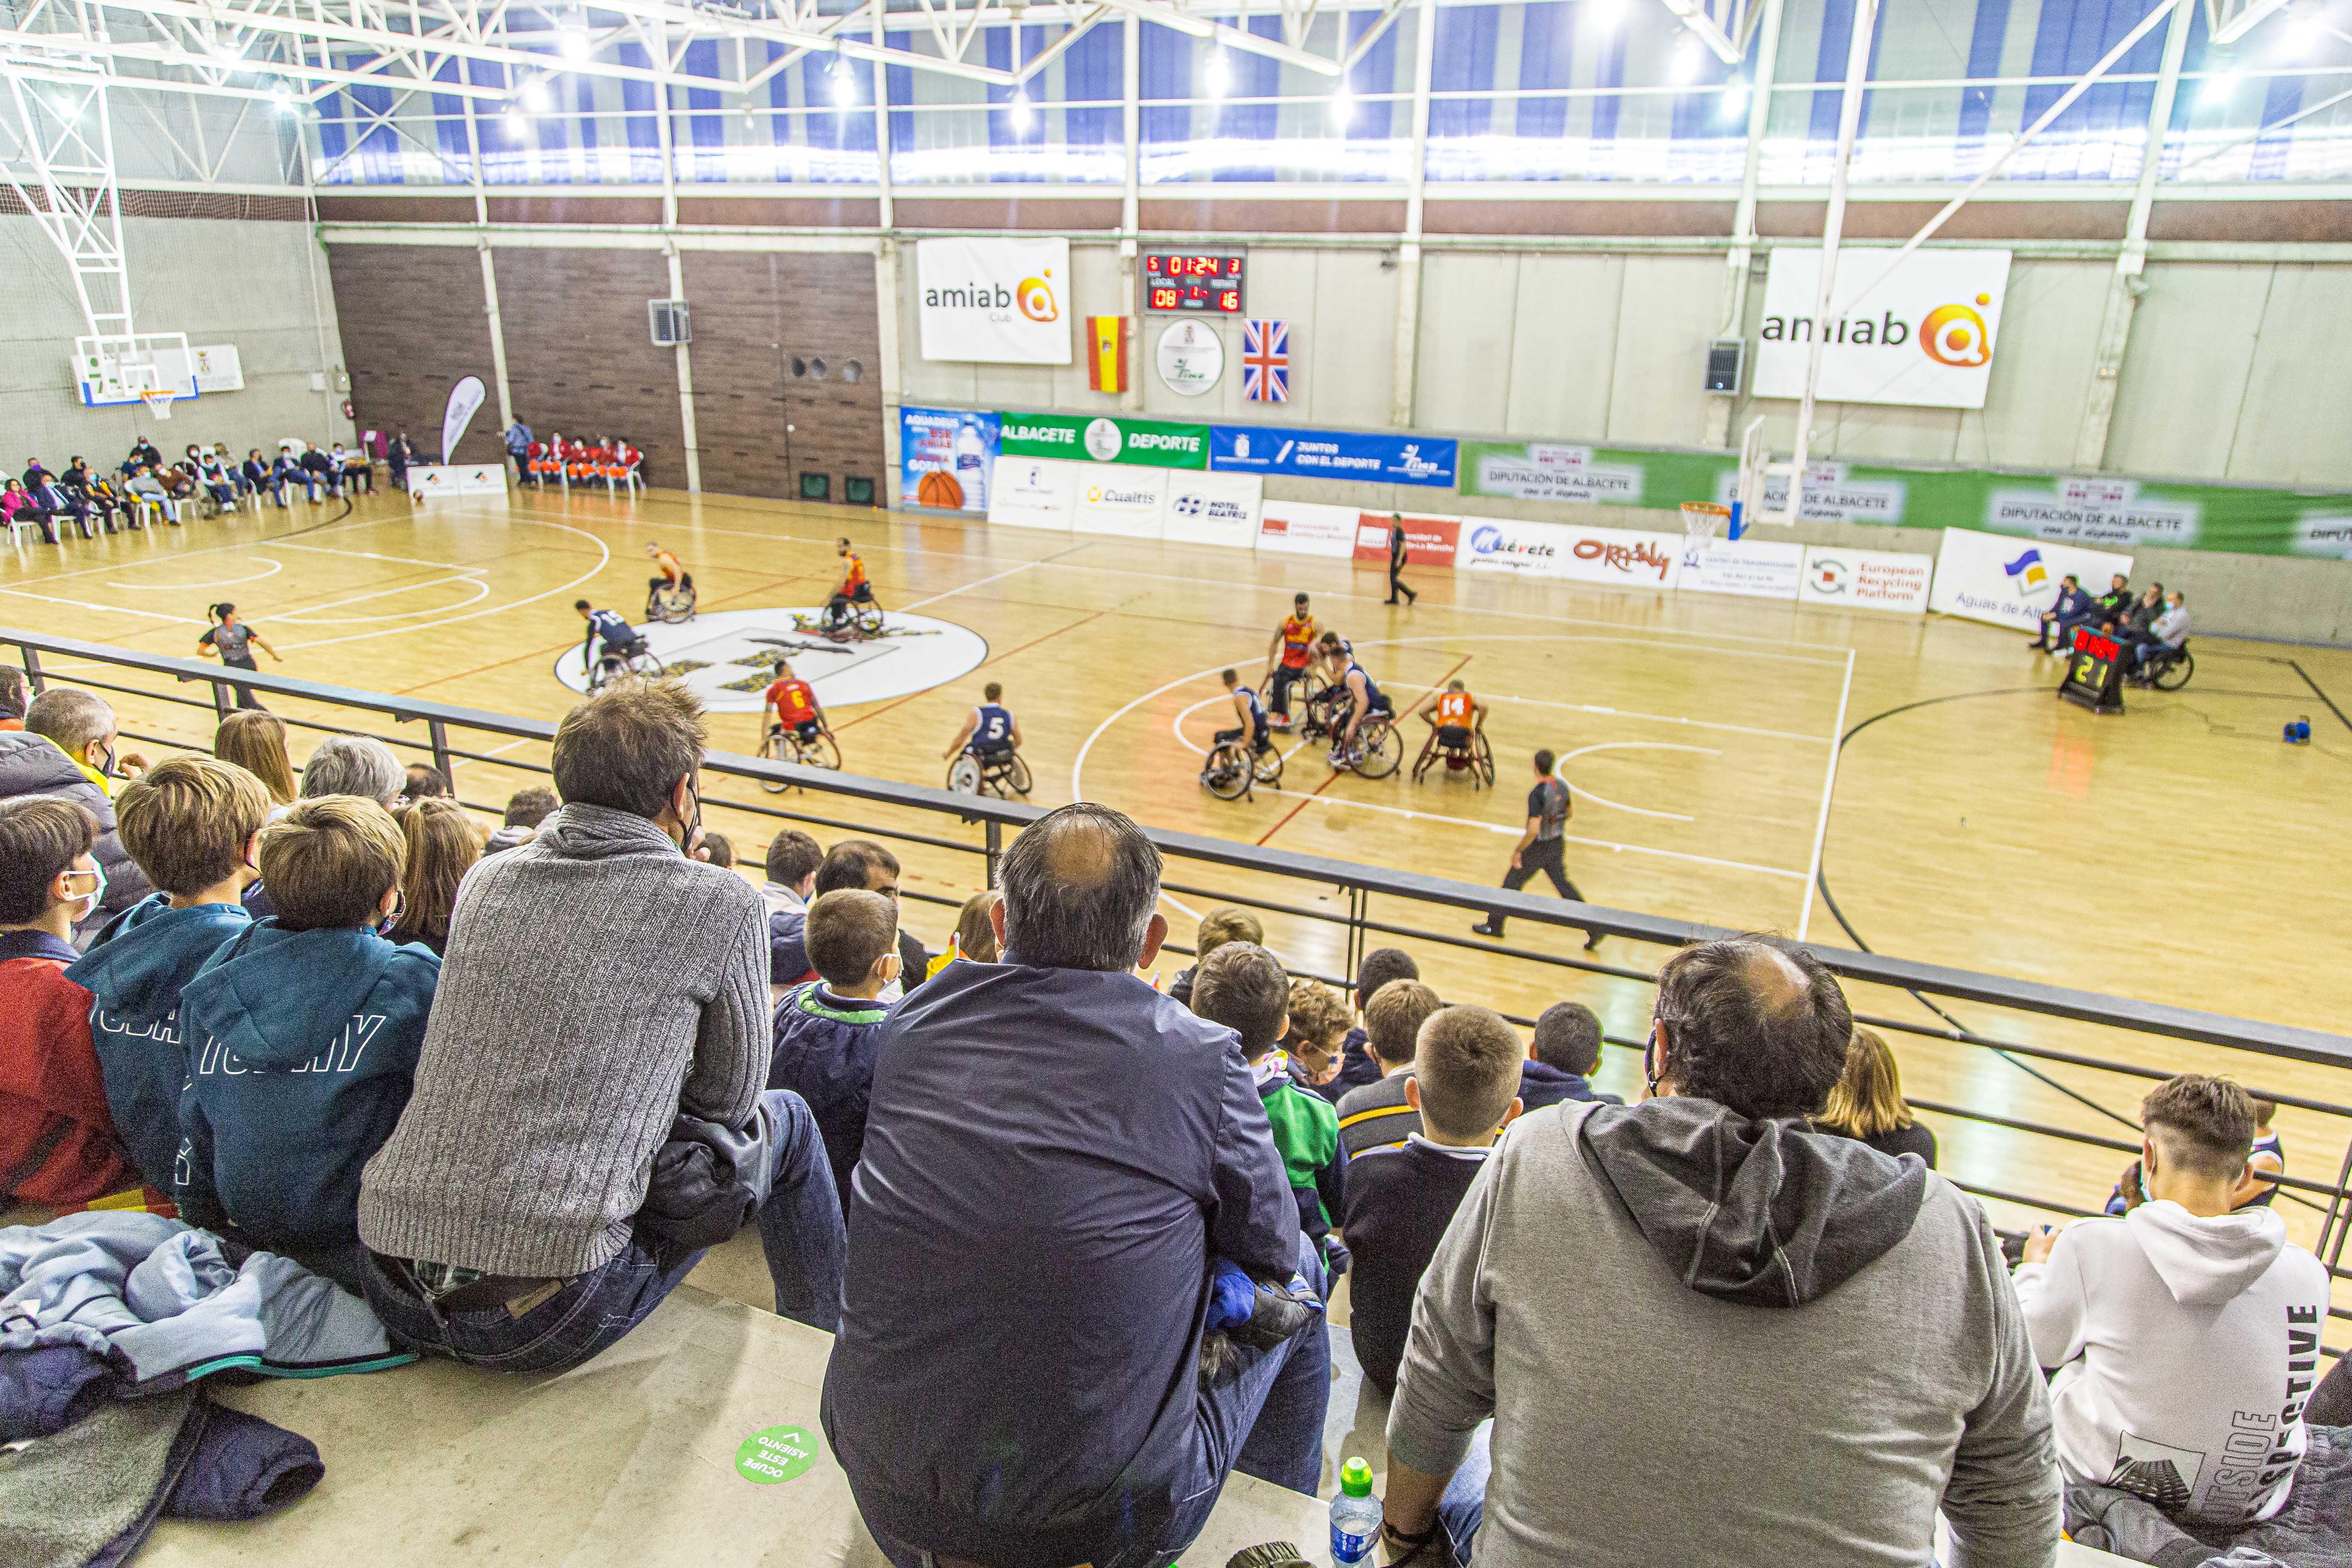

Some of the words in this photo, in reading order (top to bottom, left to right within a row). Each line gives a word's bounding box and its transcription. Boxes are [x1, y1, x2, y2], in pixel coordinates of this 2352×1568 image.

[926, 281, 1011, 308] amiab
[1152, 288, 1177, 309] 08
[1219, 291, 1239, 312] 16
[1001, 425, 1076, 444] ALBACETE
[1128, 433, 1201, 452] DEPORTE
[1859, 561, 1924, 577] European
[1858, 575, 1922, 591] Recycling
[1856, 588, 1914, 601] Platform
[1956, 592, 1998, 611] Aguas
[2074, 655, 2108, 688] 21
[1443, 698, 1464, 716] 14
[988, 717, 1004, 740] 5
[758, 1436, 809, 1459] ASIENTO
[757, 1449, 789, 1466] ESTE
[743, 1458, 784, 1478] OCUPE
